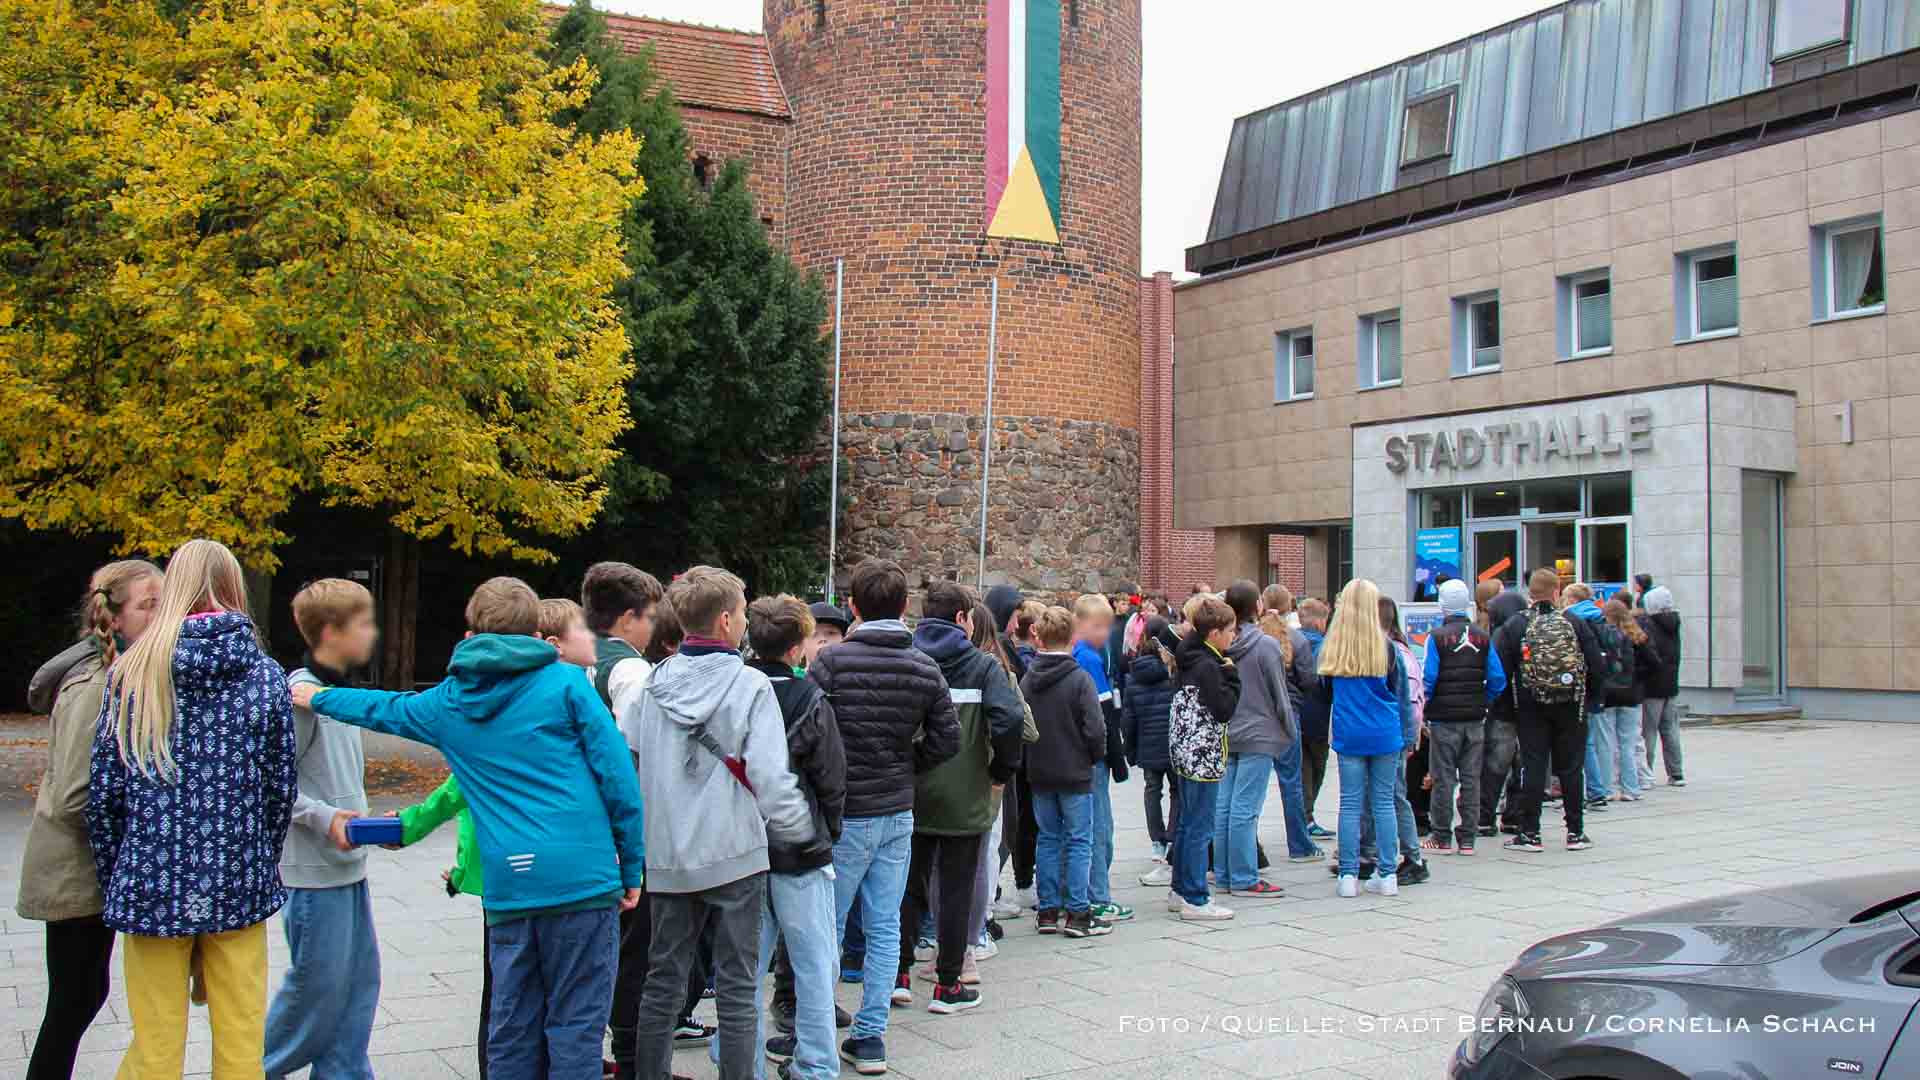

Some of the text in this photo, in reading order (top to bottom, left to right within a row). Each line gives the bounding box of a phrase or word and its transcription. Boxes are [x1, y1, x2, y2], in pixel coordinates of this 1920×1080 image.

[1385, 407, 1652, 474] STADTHALLE
[1832, 400, 1855, 445] 1
[1831, 1061, 1861, 1072] JOIN
